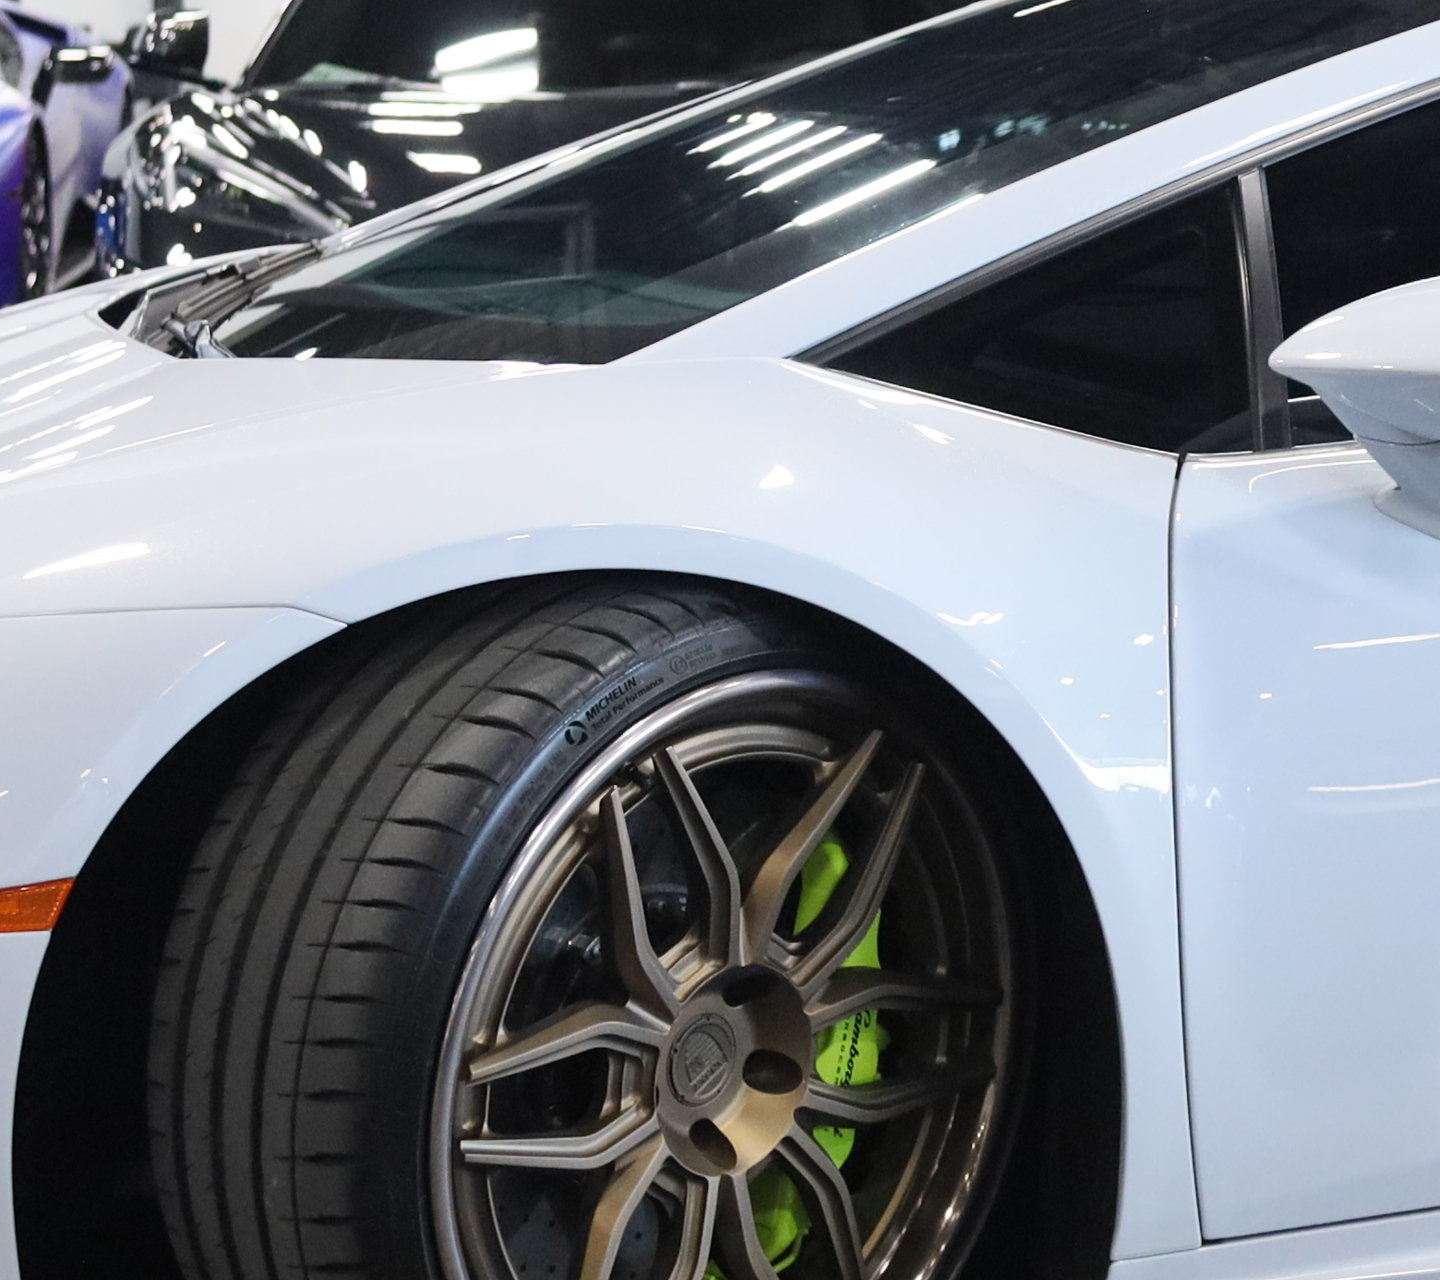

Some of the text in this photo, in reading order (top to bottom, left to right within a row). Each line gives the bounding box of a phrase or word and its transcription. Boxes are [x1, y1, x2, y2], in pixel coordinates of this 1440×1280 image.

[585, 676, 638, 721] MICHELIN
[591, 676, 665, 731] Total Performance
